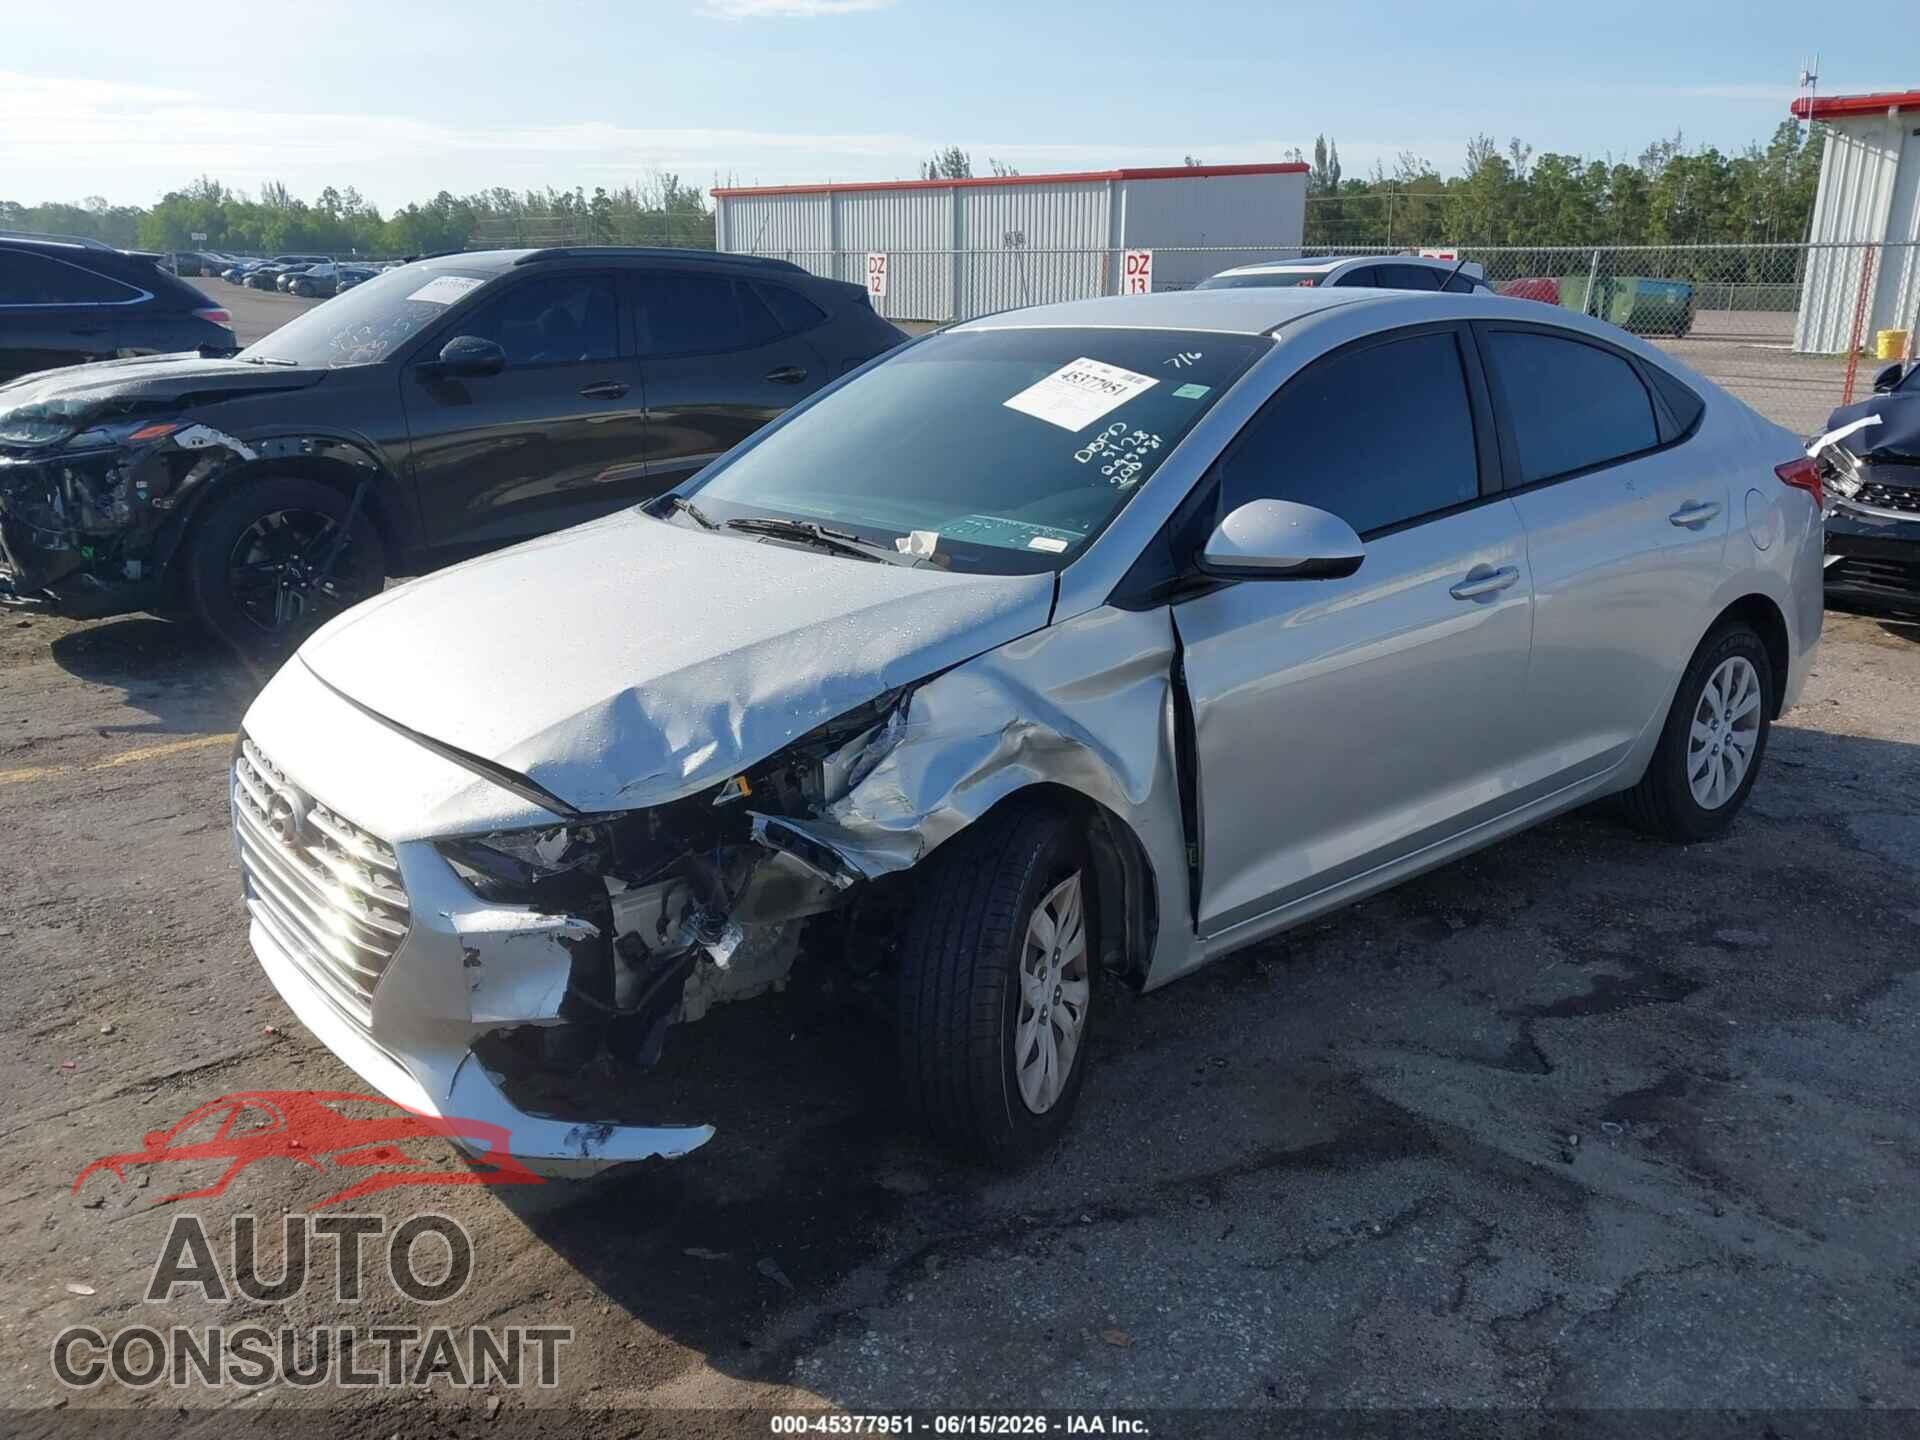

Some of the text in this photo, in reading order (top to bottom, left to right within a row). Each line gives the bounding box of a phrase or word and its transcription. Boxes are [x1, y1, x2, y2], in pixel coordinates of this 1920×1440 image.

[869, 257, 885, 274] DZ
[1127, 255, 1150, 275] DZ
[871, 276, 881, 292] 12
[1131, 278, 1145, 295] 13
[1061, 370, 1128, 396] 45377951
